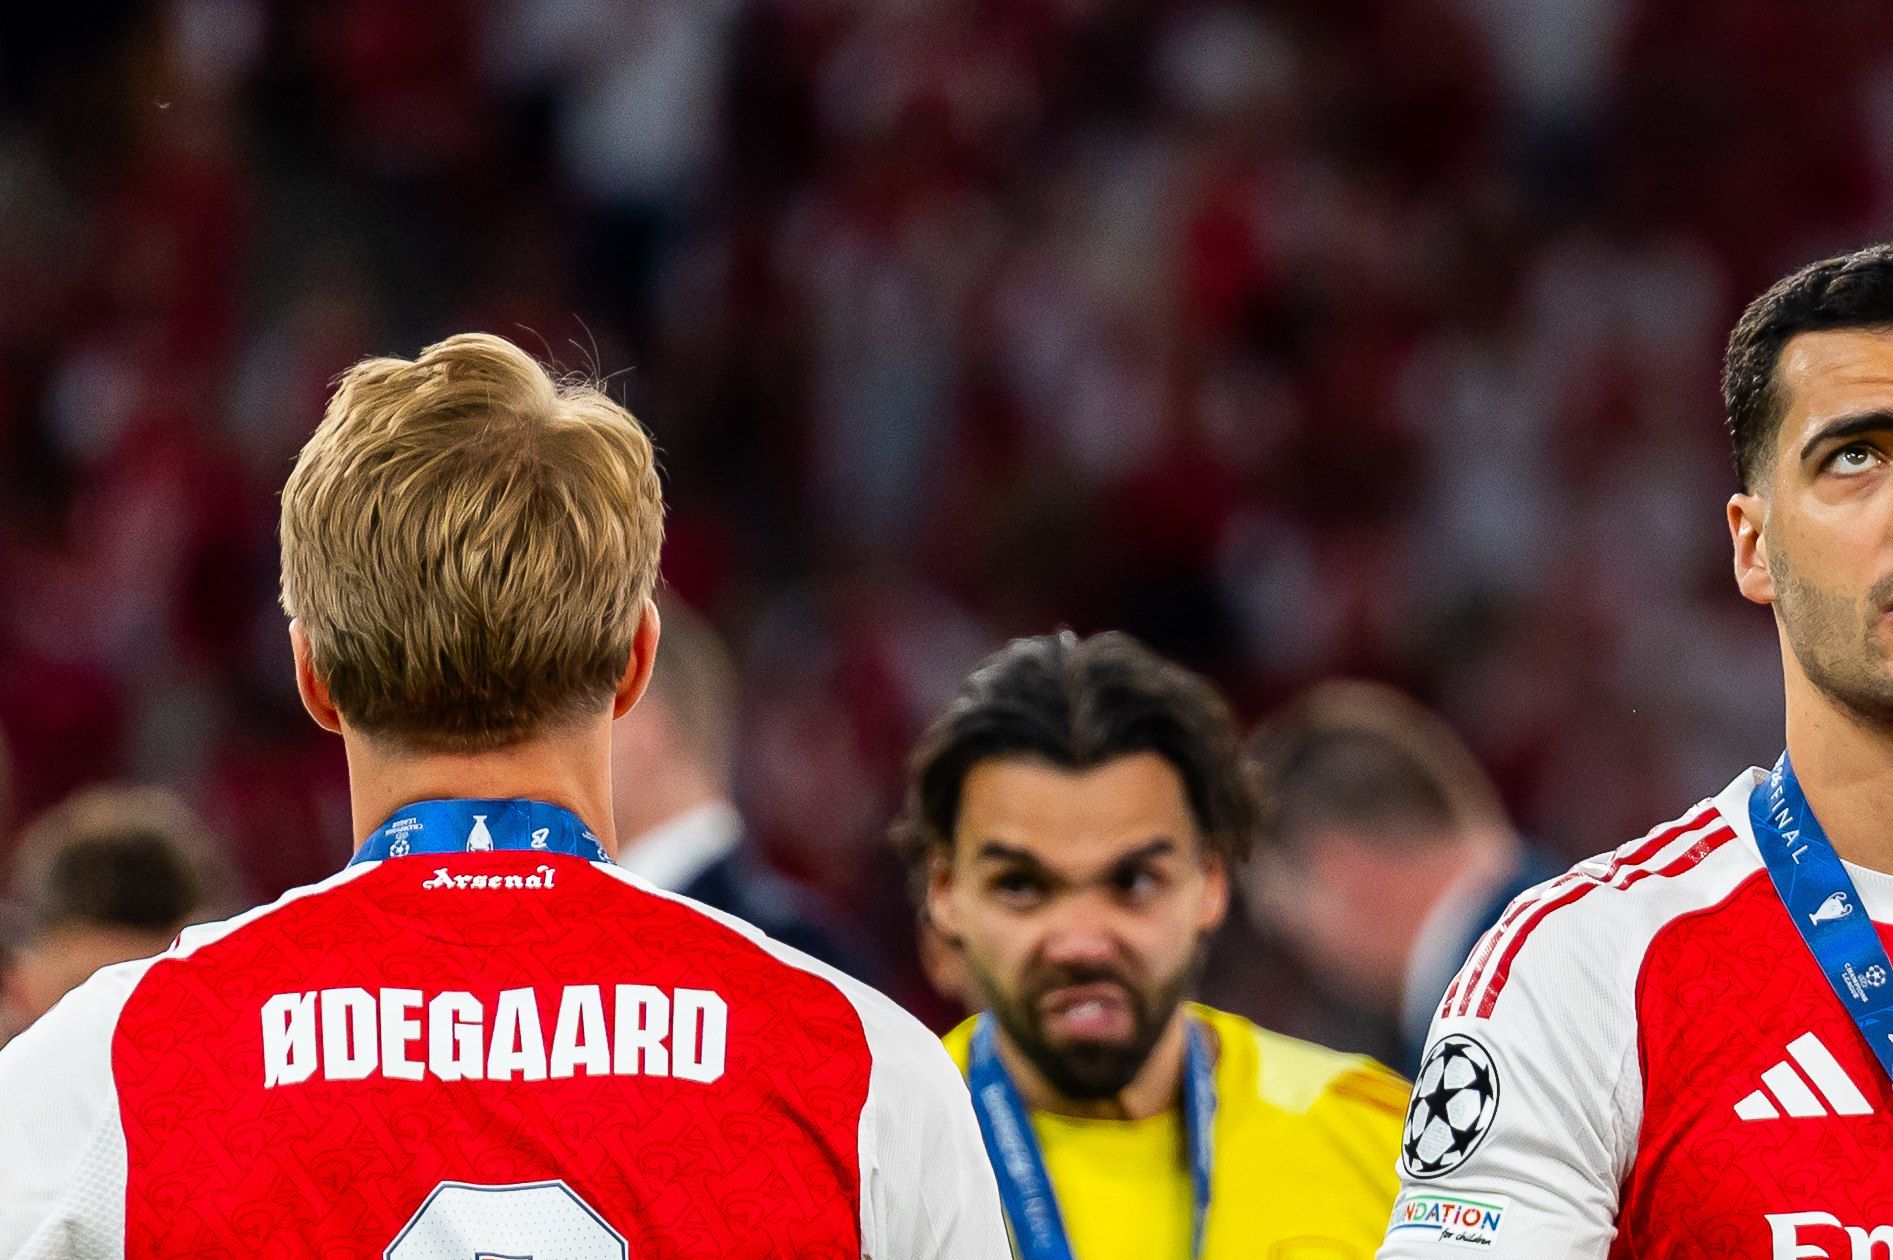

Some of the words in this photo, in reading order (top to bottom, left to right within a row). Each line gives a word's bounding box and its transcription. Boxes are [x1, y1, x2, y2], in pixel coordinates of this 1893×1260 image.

[1770, 785, 1809, 865] FINAL
[421, 864, 557, 891] Arsenal
[260, 983, 729, 1089] ØDEGAARD
